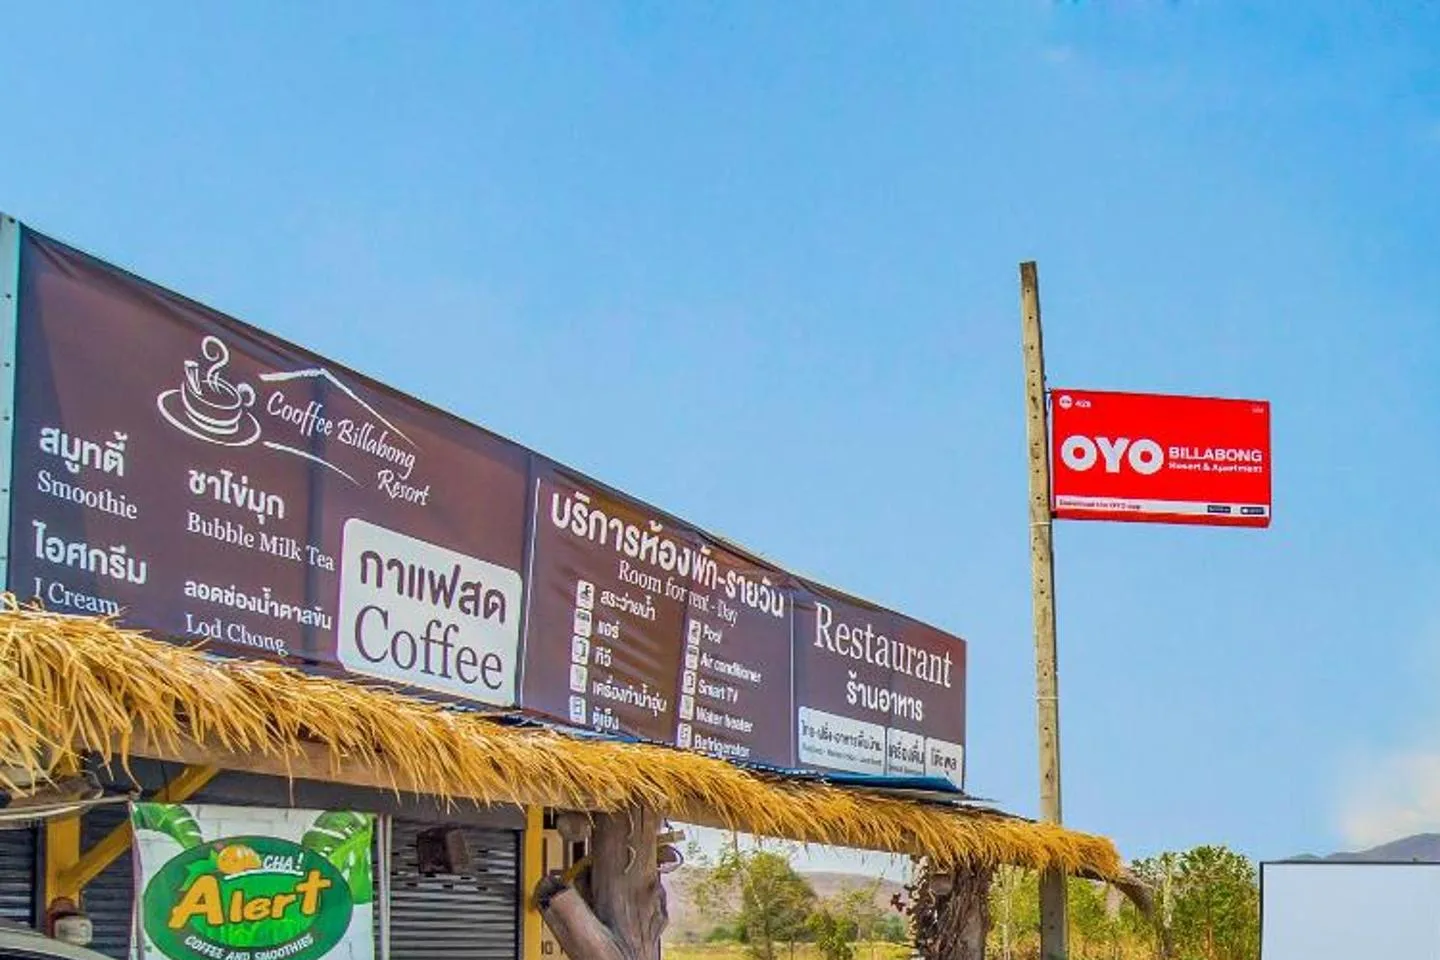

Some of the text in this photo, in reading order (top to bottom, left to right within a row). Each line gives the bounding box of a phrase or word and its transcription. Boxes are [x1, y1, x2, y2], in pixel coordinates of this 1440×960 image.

[39, 427, 129, 477] สมูทตี้
[267, 391, 416, 479] Cooffee Billabong
[1061, 434, 1164, 476] OYO
[1168, 446, 1263, 463] BILLABONG
[37, 469, 138, 520] Smoothie
[187, 469, 286, 525] ชาไข่มุก
[377, 469, 431, 506] Resort
[32, 519, 148, 585] ไอศกรีม
[186, 509, 336, 572] Bubble Milk Tea
[49, 582, 121, 617] Cream
[360, 550, 507, 625] กาแฟสด
[618, 560, 662, 594] Room
[665, 577, 688, 602] for
[184, 612, 289, 658] Lod Chong
[354, 605, 503, 690] Coffee
[813, 601, 953, 688] Restaurant
[698, 679, 725, 700] Smart
[846, 670, 923, 721] ร้านอาหาร
[696, 705, 723, 726] Water
[168, 870, 332, 929] Alert
[184, 935, 225, 960] COFFEE
